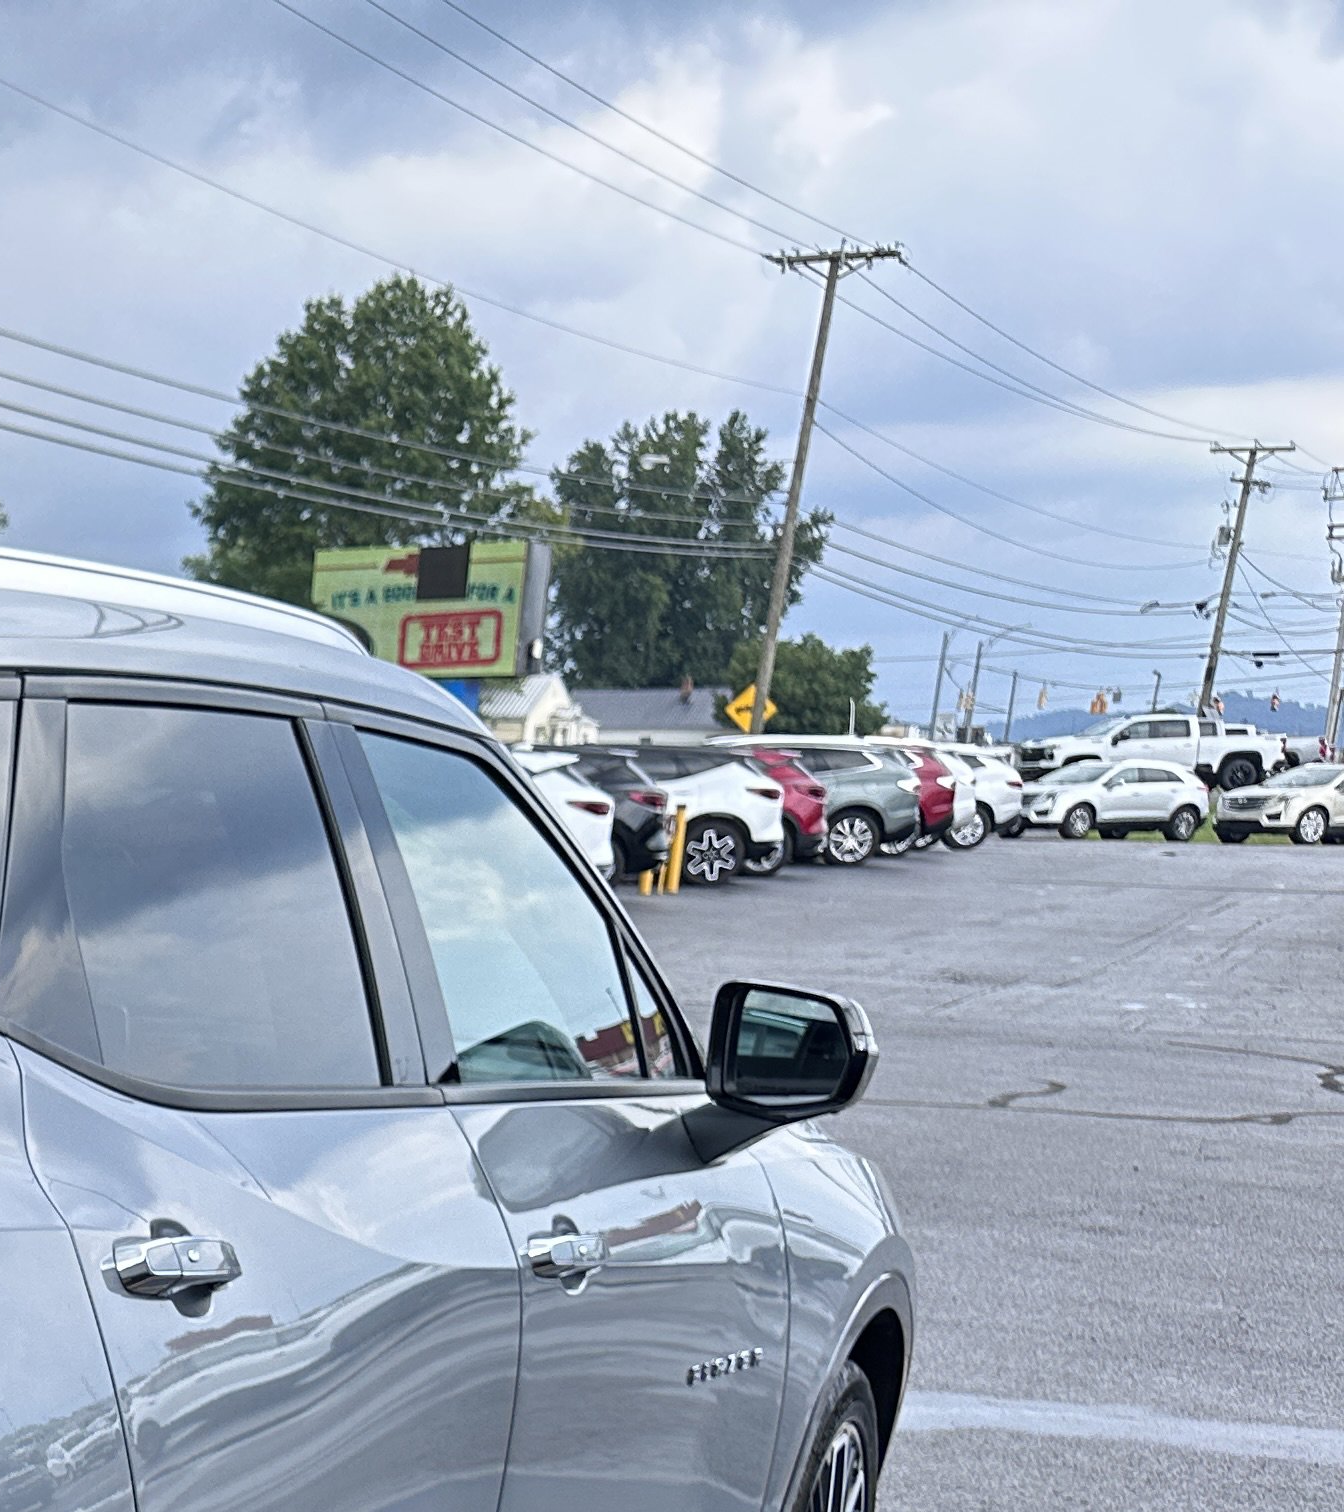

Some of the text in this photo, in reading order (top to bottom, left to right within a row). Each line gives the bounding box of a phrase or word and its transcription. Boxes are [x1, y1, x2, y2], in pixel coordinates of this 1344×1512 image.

[365, 588, 378, 605] A
[503, 583, 516, 603] A
[419, 617, 481, 643] TEST
[419, 641, 480, 664] DRIVE
